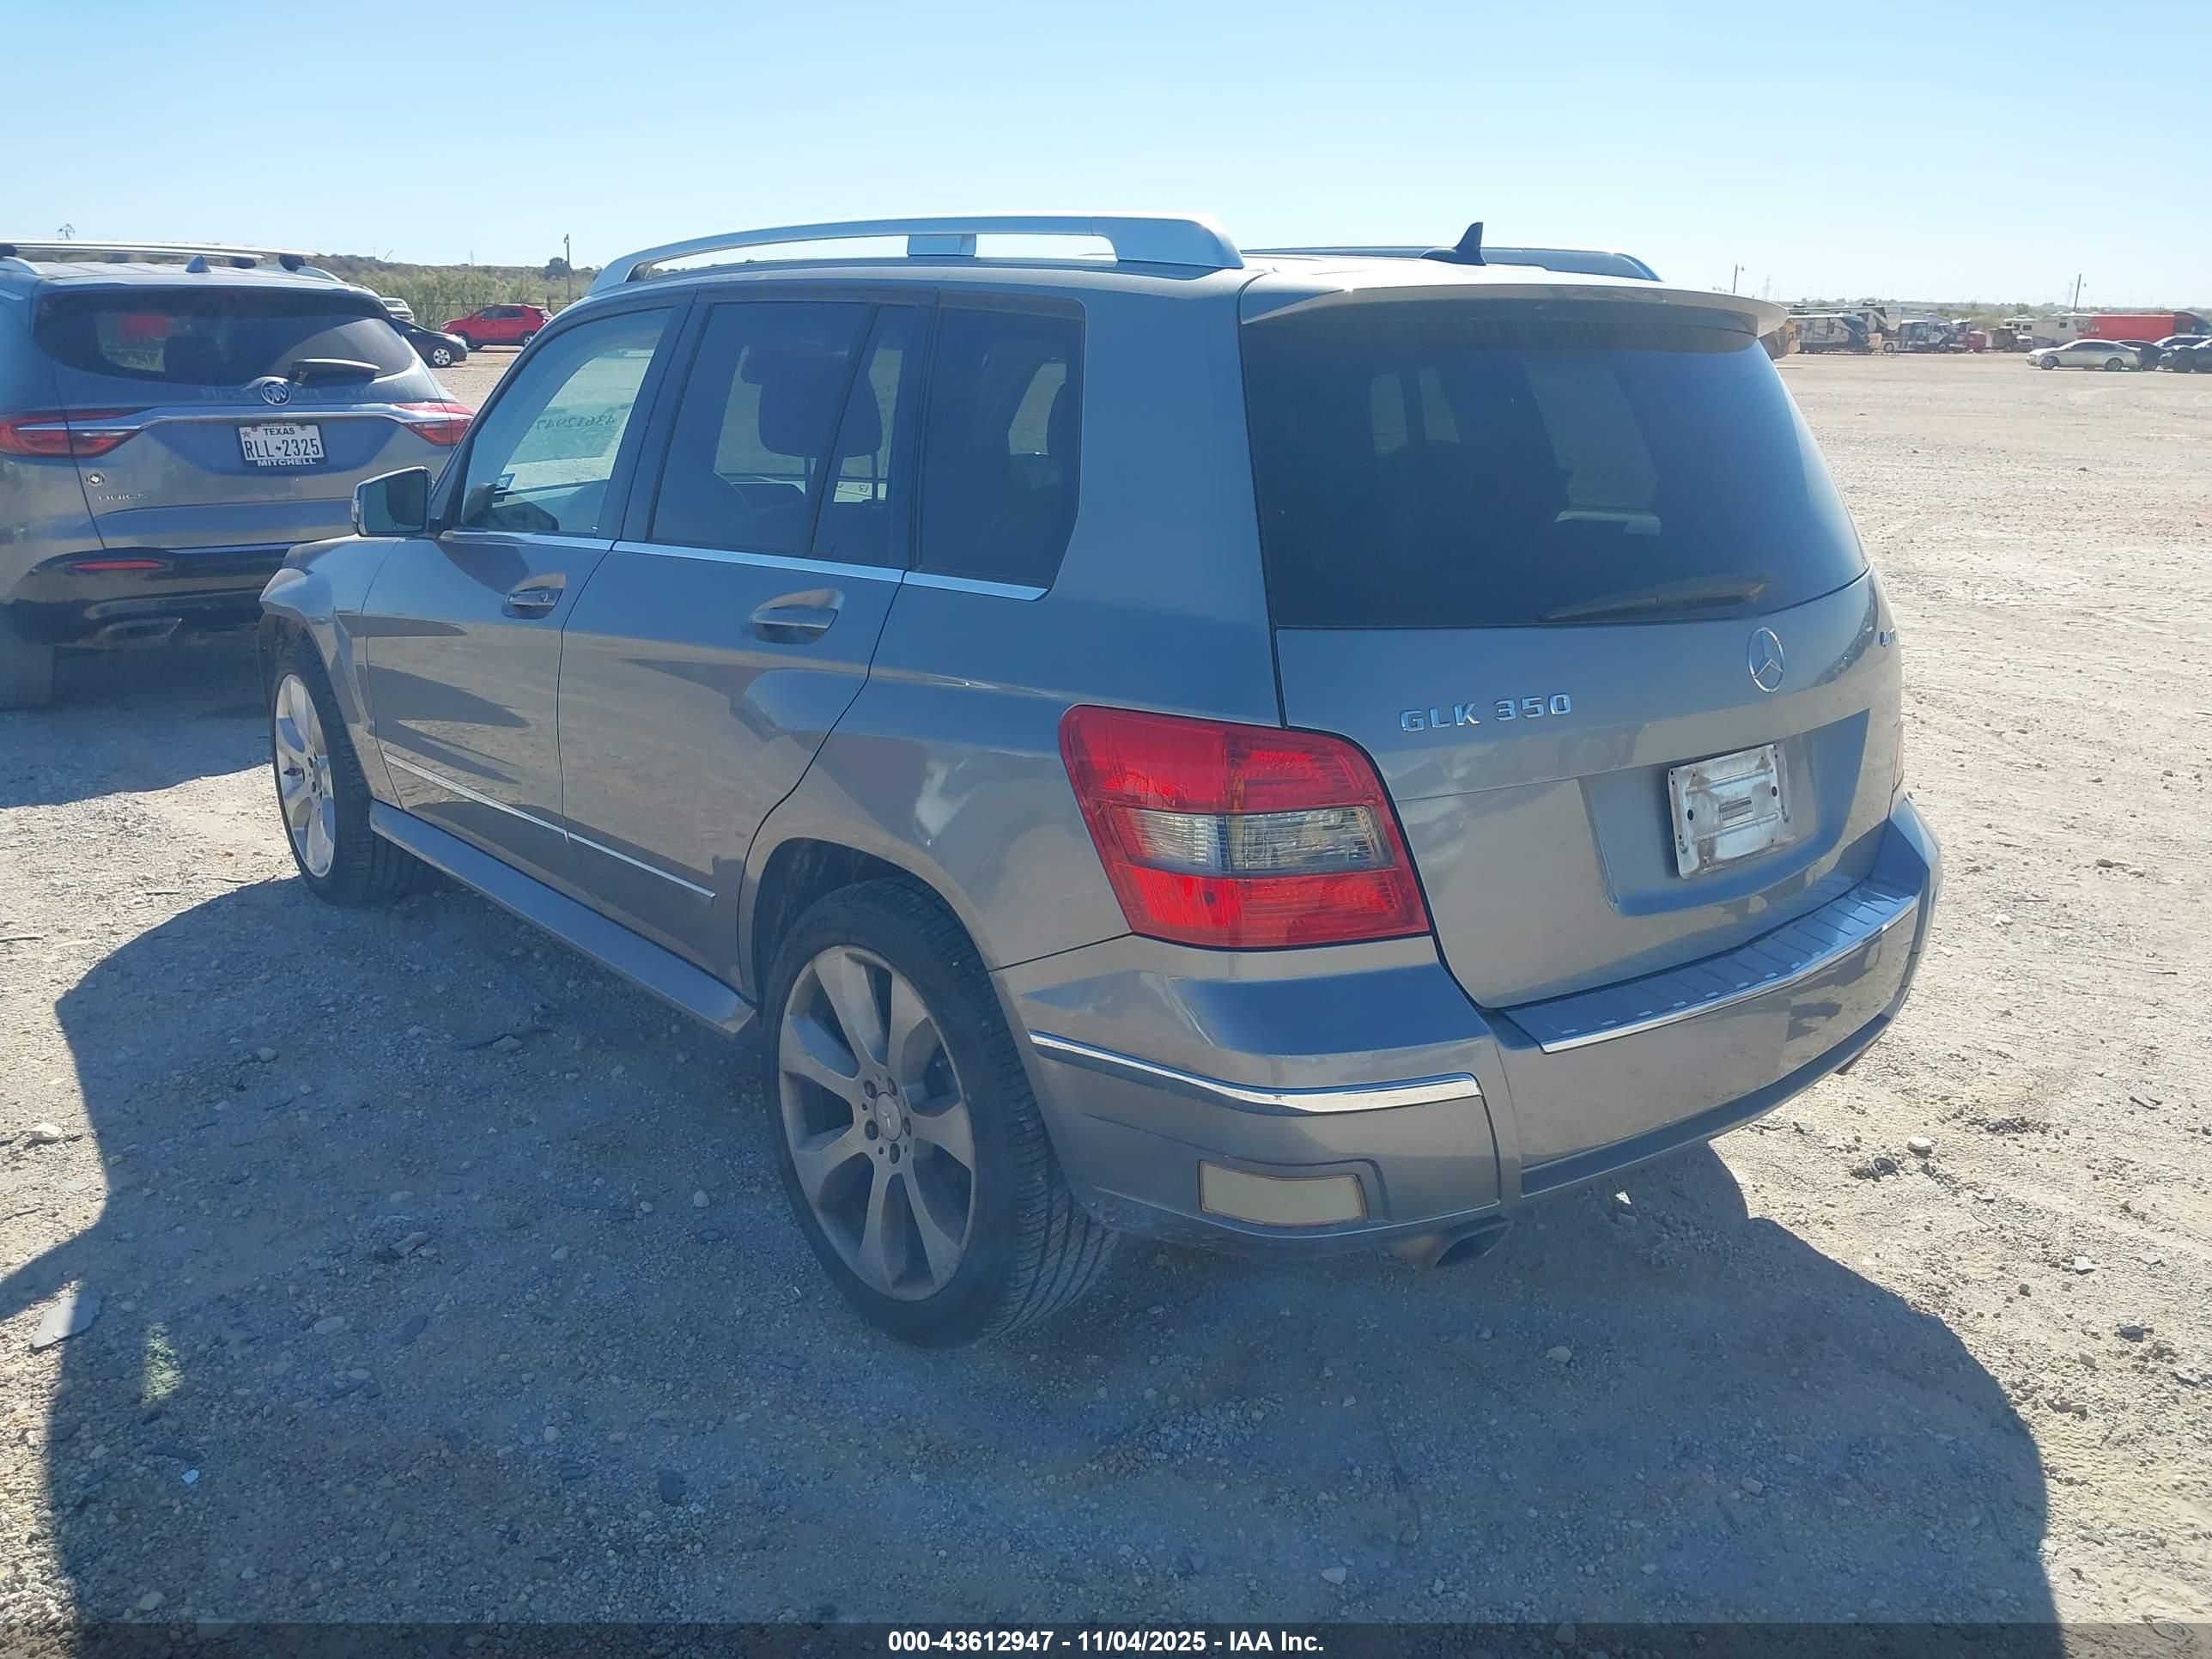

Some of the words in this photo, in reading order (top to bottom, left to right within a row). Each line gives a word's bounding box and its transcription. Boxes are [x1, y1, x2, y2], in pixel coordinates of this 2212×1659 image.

[262, 427, 295, 436] TEXAS
[257, 458, 317, 467] MITCHELL
[1400, 702, 1481, 732] GLK
[1493, 692, 1572, 721] 350
